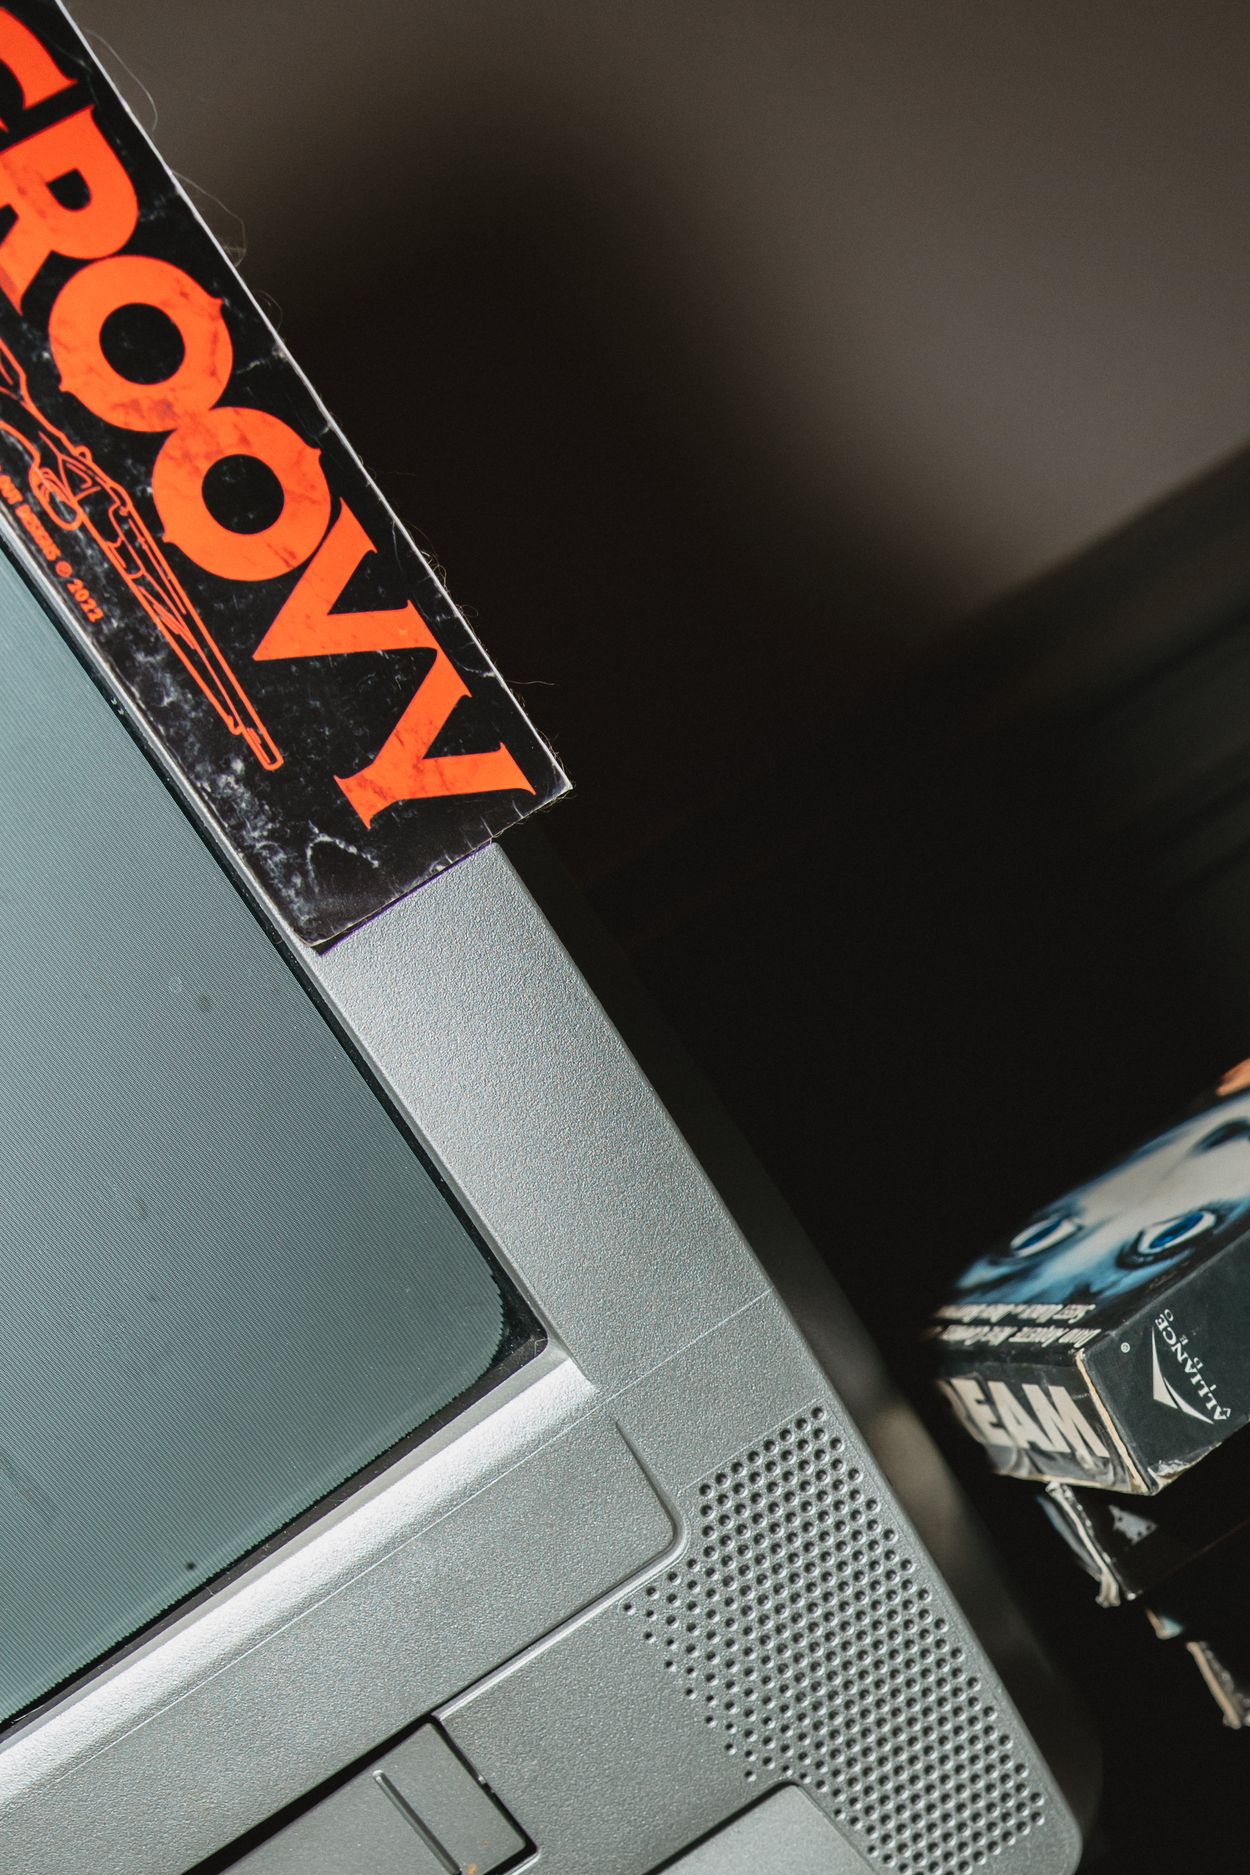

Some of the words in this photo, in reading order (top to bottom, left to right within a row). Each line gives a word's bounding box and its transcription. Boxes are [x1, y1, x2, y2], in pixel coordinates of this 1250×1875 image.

[66, 578, 104, 623] 2022
[1154, 1316, 1229, 1422] ALLIANCE
[1164, 1308, 1232, 1419] VIDEO
